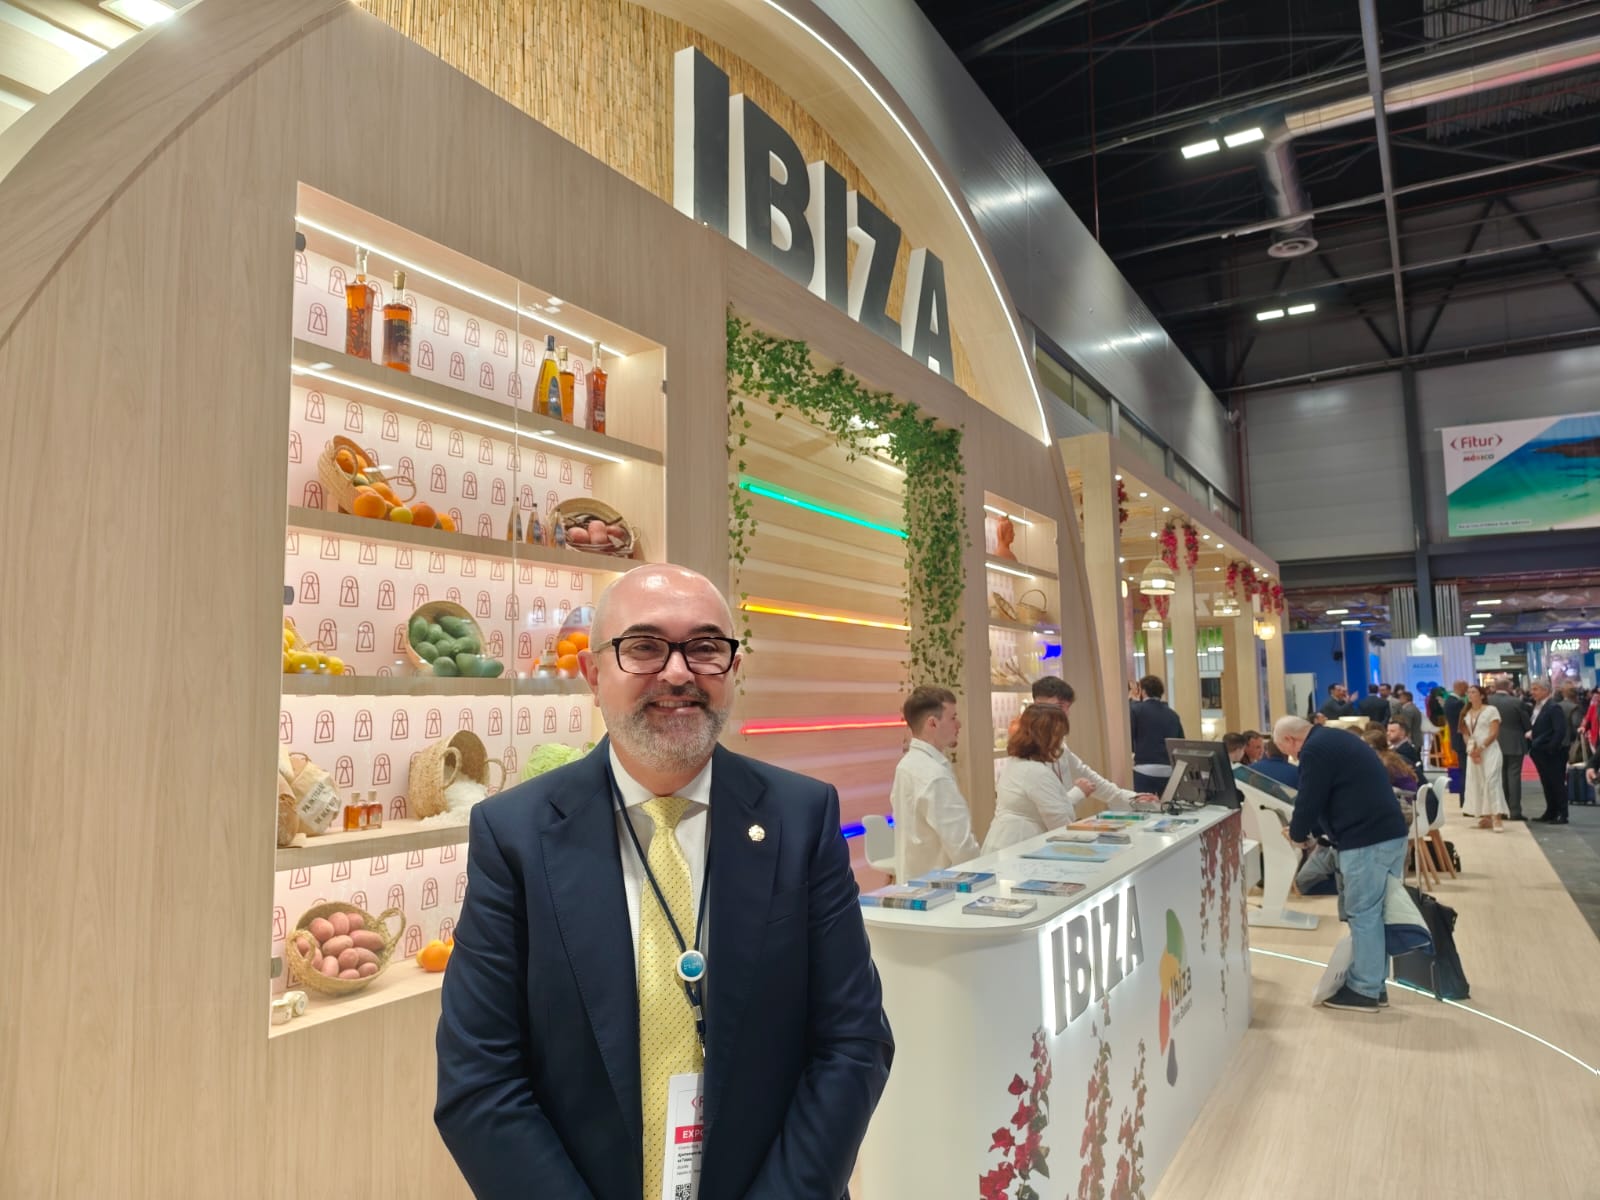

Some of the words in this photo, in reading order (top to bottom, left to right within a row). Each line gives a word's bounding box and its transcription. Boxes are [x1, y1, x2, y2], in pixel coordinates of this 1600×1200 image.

[673, 45, 956, 385] IBIZA
[1461, 436, 1494, 448] Fitur
[1051, 885, 1144, 1036] IBIZA
[1170, 965, 1192, 1010] Ibiza
